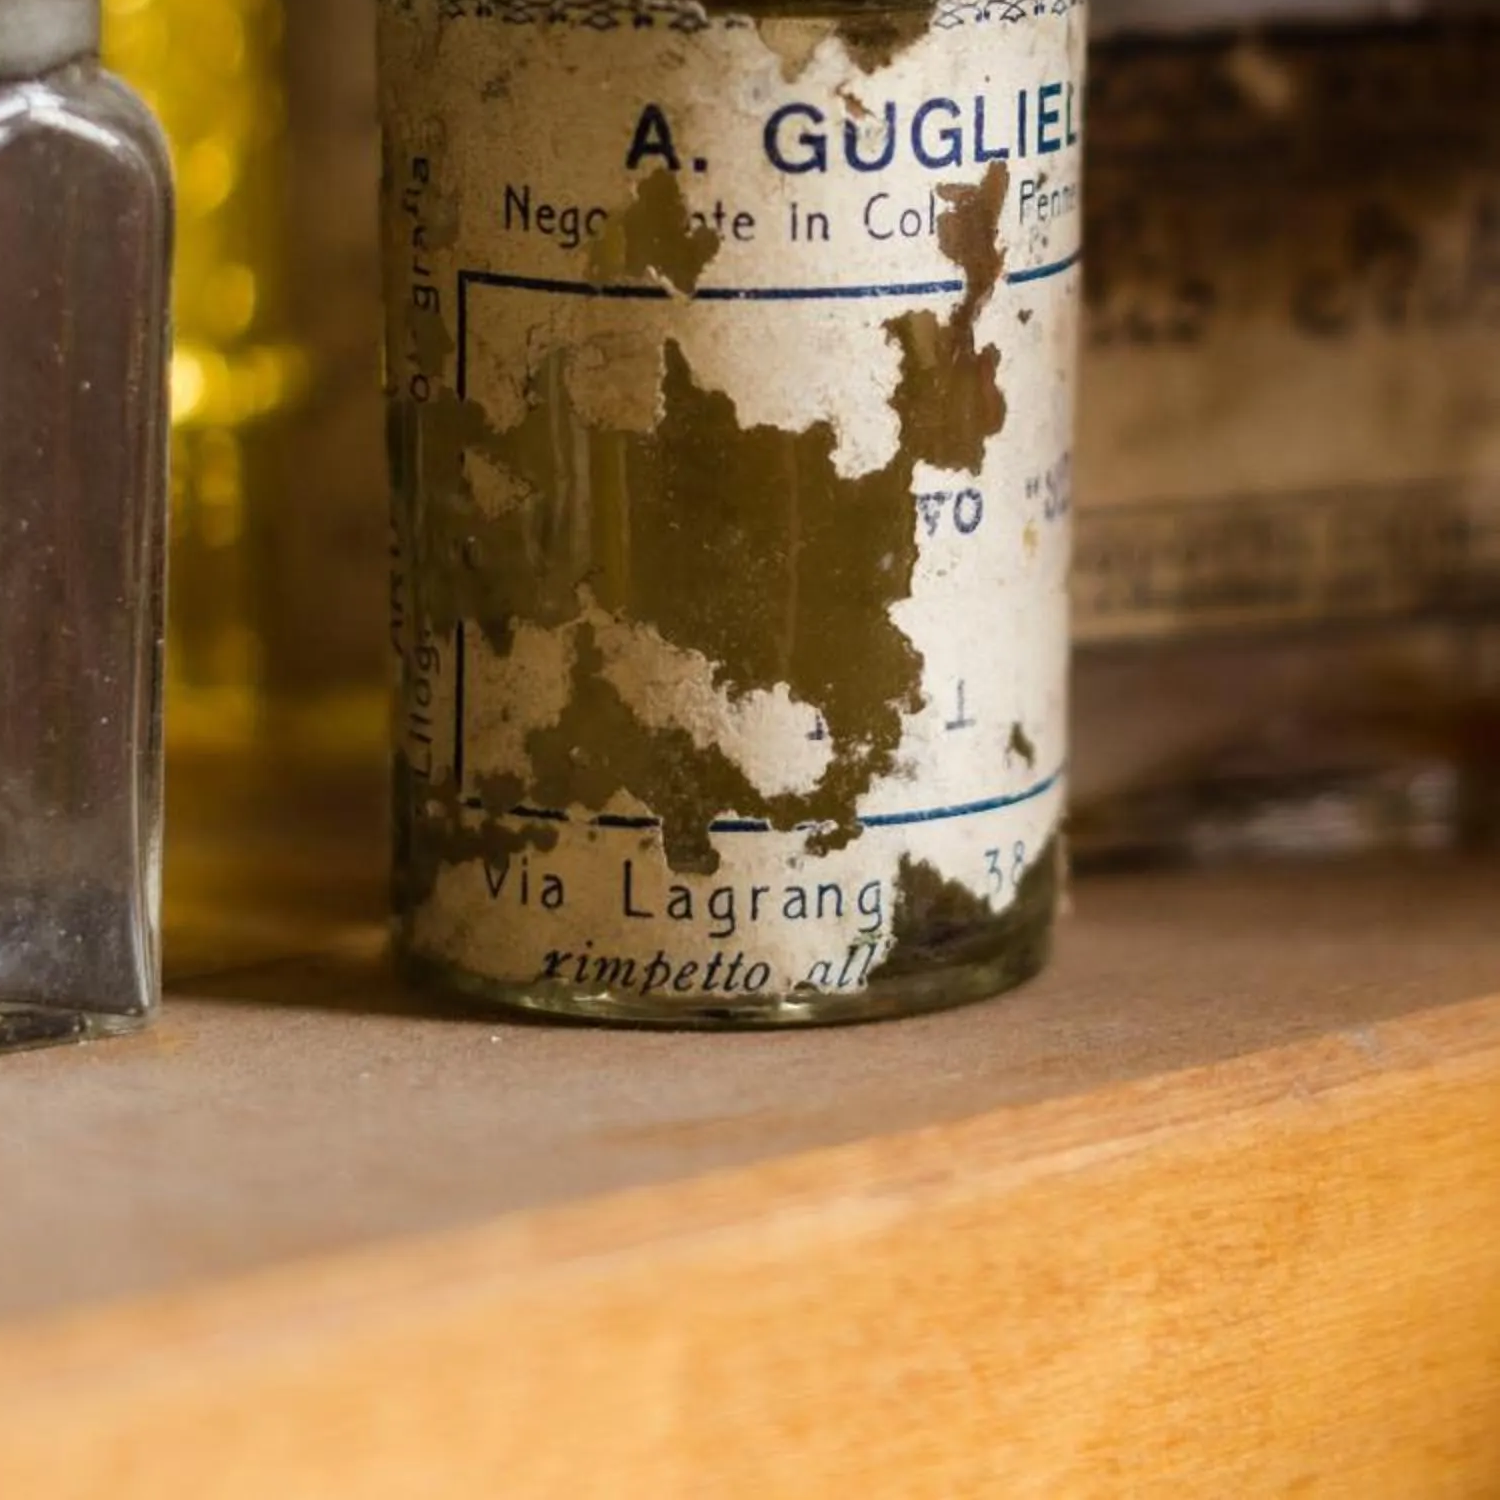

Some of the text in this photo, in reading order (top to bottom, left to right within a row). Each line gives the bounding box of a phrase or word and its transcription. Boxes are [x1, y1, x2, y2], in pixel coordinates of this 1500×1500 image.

[625, 81, 1078, 175] A. GUGLIEL
[789, 202, 831, 243] in
[483, 855, 564, 910] Via
[541, 939, 772, 997] rimpetto
